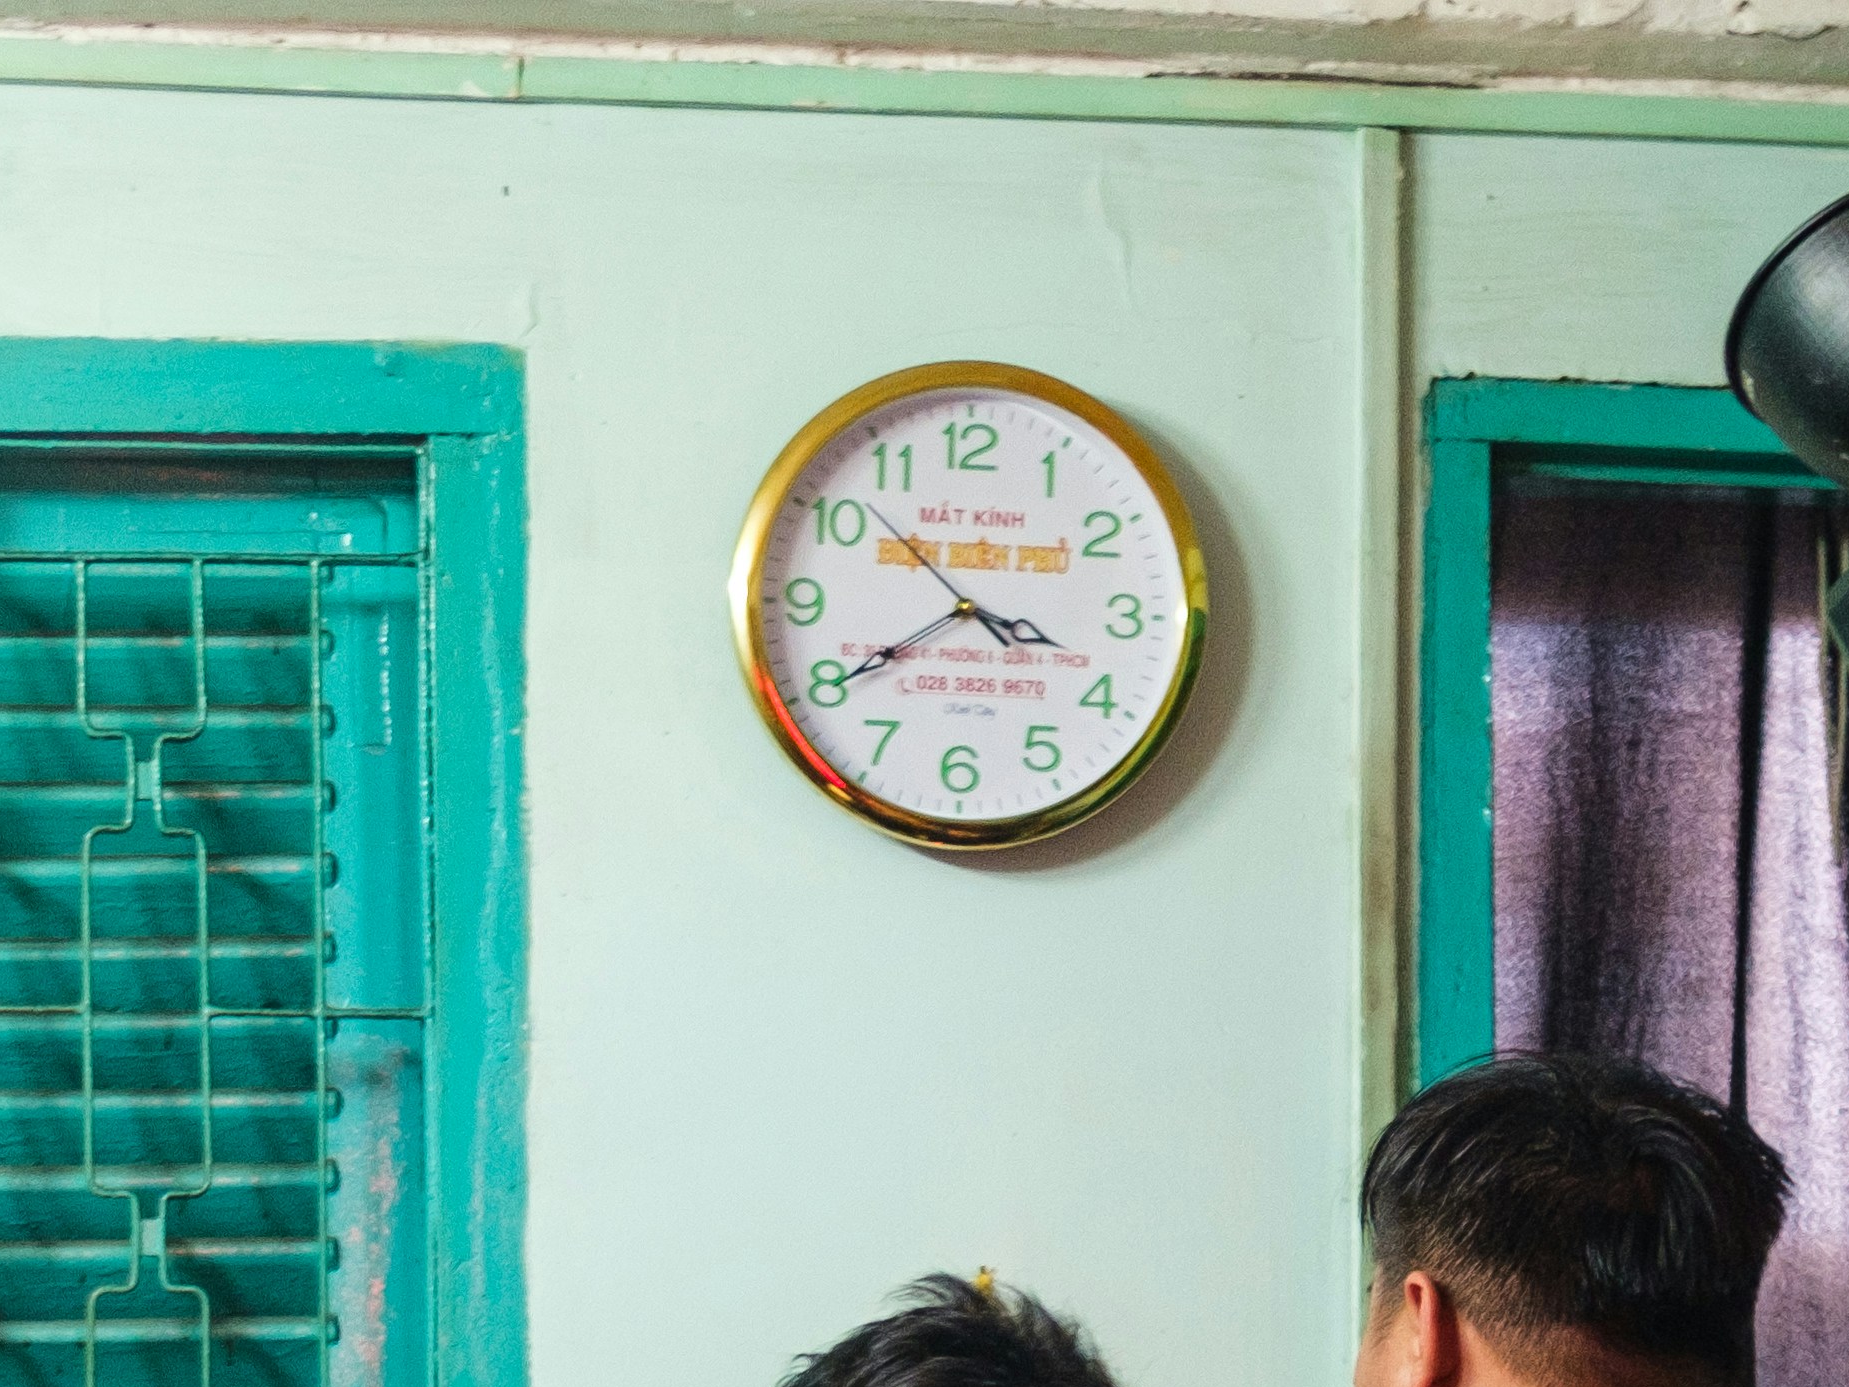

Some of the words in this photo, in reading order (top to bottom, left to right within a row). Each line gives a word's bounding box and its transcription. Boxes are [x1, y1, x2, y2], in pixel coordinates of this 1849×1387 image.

[871, 443, 914, 493] 11
[943, 421, 999, 471] 12
[1040, 450, 1057, 498] 1
[813, 497, 867, 547] 10
[1082, 510, 1122, 558] 2
[785, 577, 825, 626] 9
[1105, 593, 1144, 639] 3
[808, 659, 849, 707] 8
[1079, 674, 1118, 719] 4
[863, 719, 901, 766] 7
[1022, 726, 1062, 772] 5
[940, 745, 981, 793] 6
